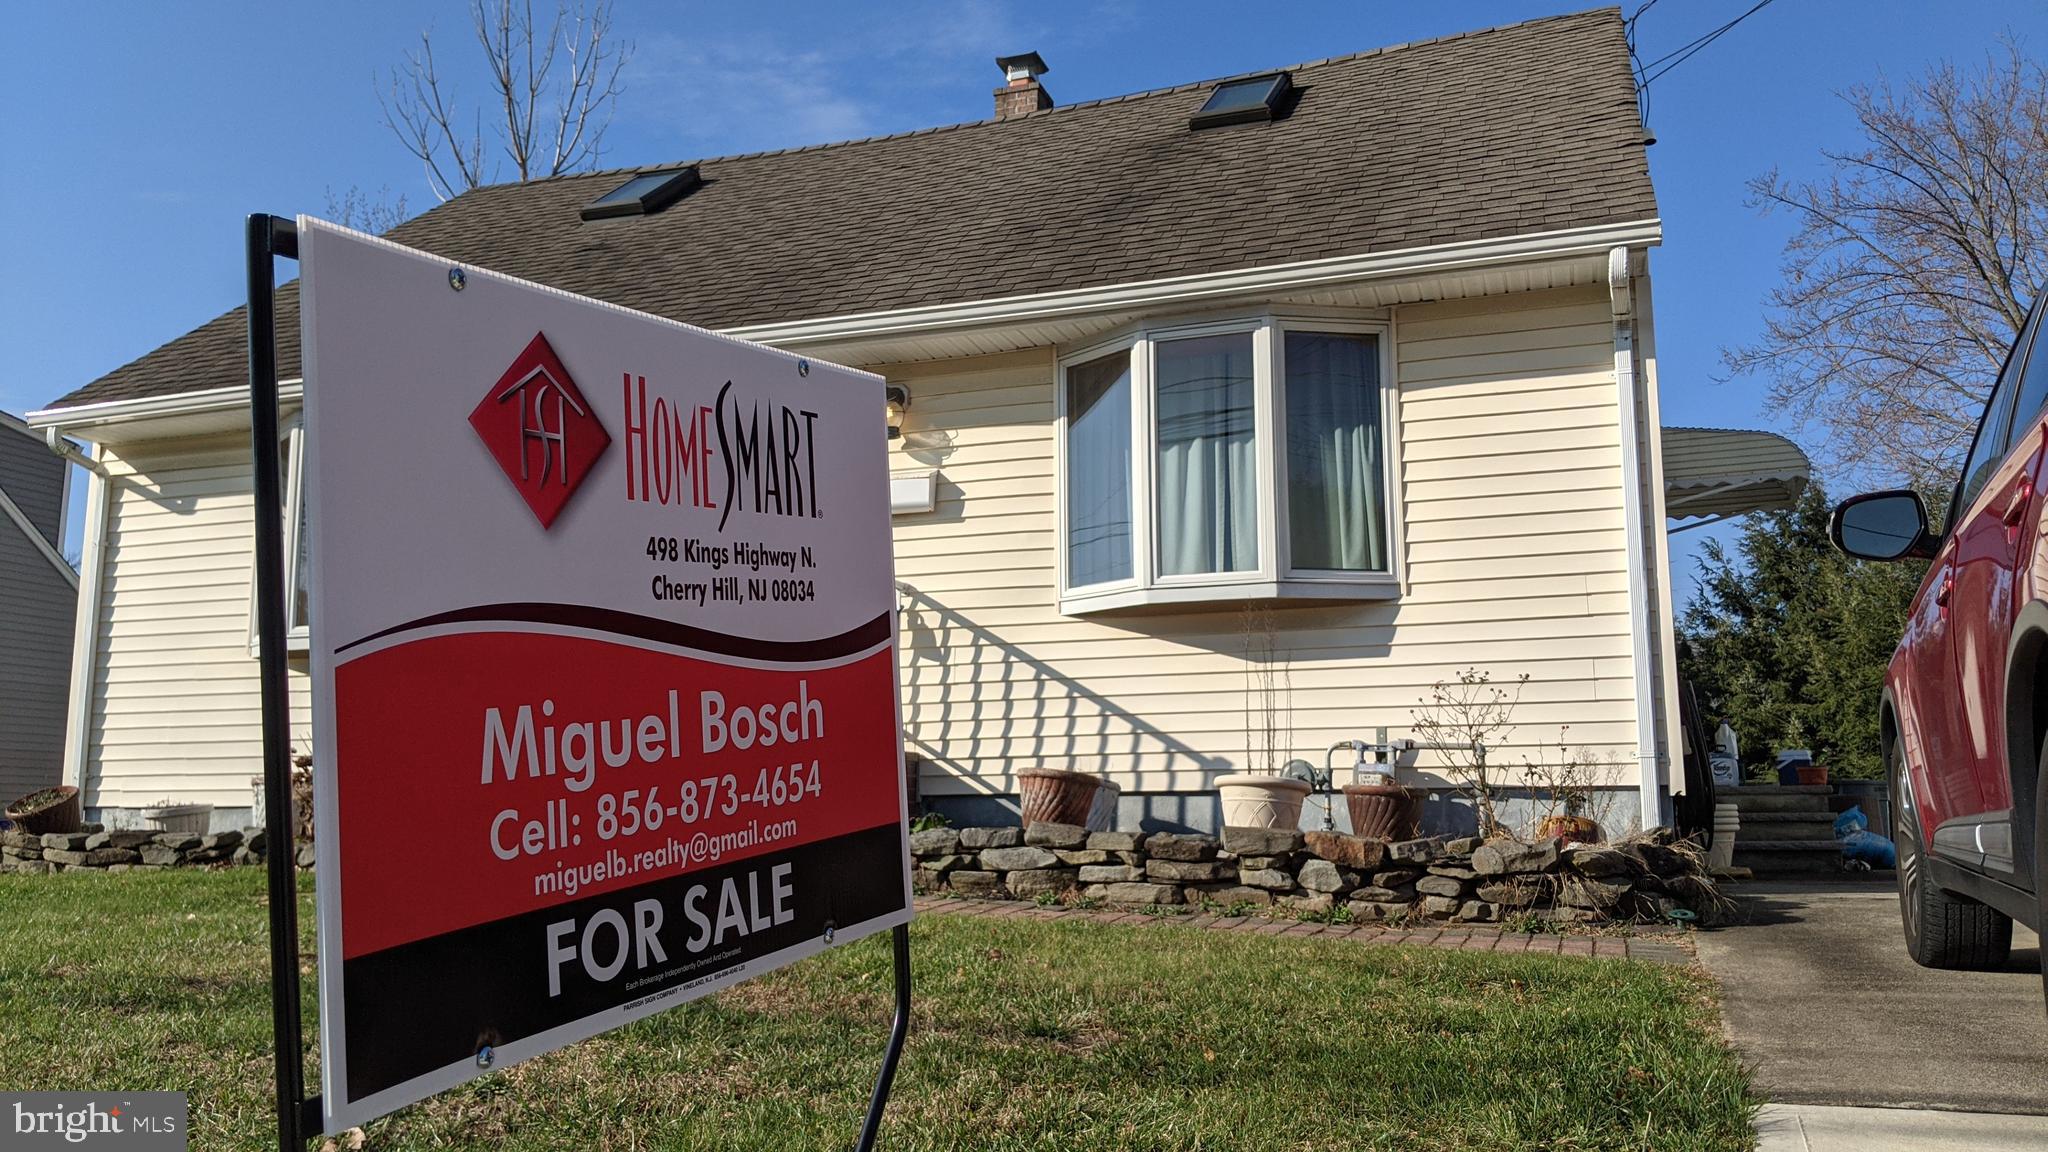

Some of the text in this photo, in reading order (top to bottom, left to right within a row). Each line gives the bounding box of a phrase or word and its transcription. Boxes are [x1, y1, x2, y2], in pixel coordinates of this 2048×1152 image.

[646, 536, 817, 573] 498 Kings Highway N.
[652, 575, 815, 607] Cherry Hill, NJ 08034
[481, 680, 825, 792] Miguel Bosch
[490, 759, 822, 861] Cell: 856-873-4654
[534, 819, 798, 896] miguelb.realty@gmail.com
[546, 862, 795, 998] FOR SALE
[625, 981, 639, 991] Each
[640, 973, 664, 987] Brokerage
[665, 962, 696, 978] Independently
